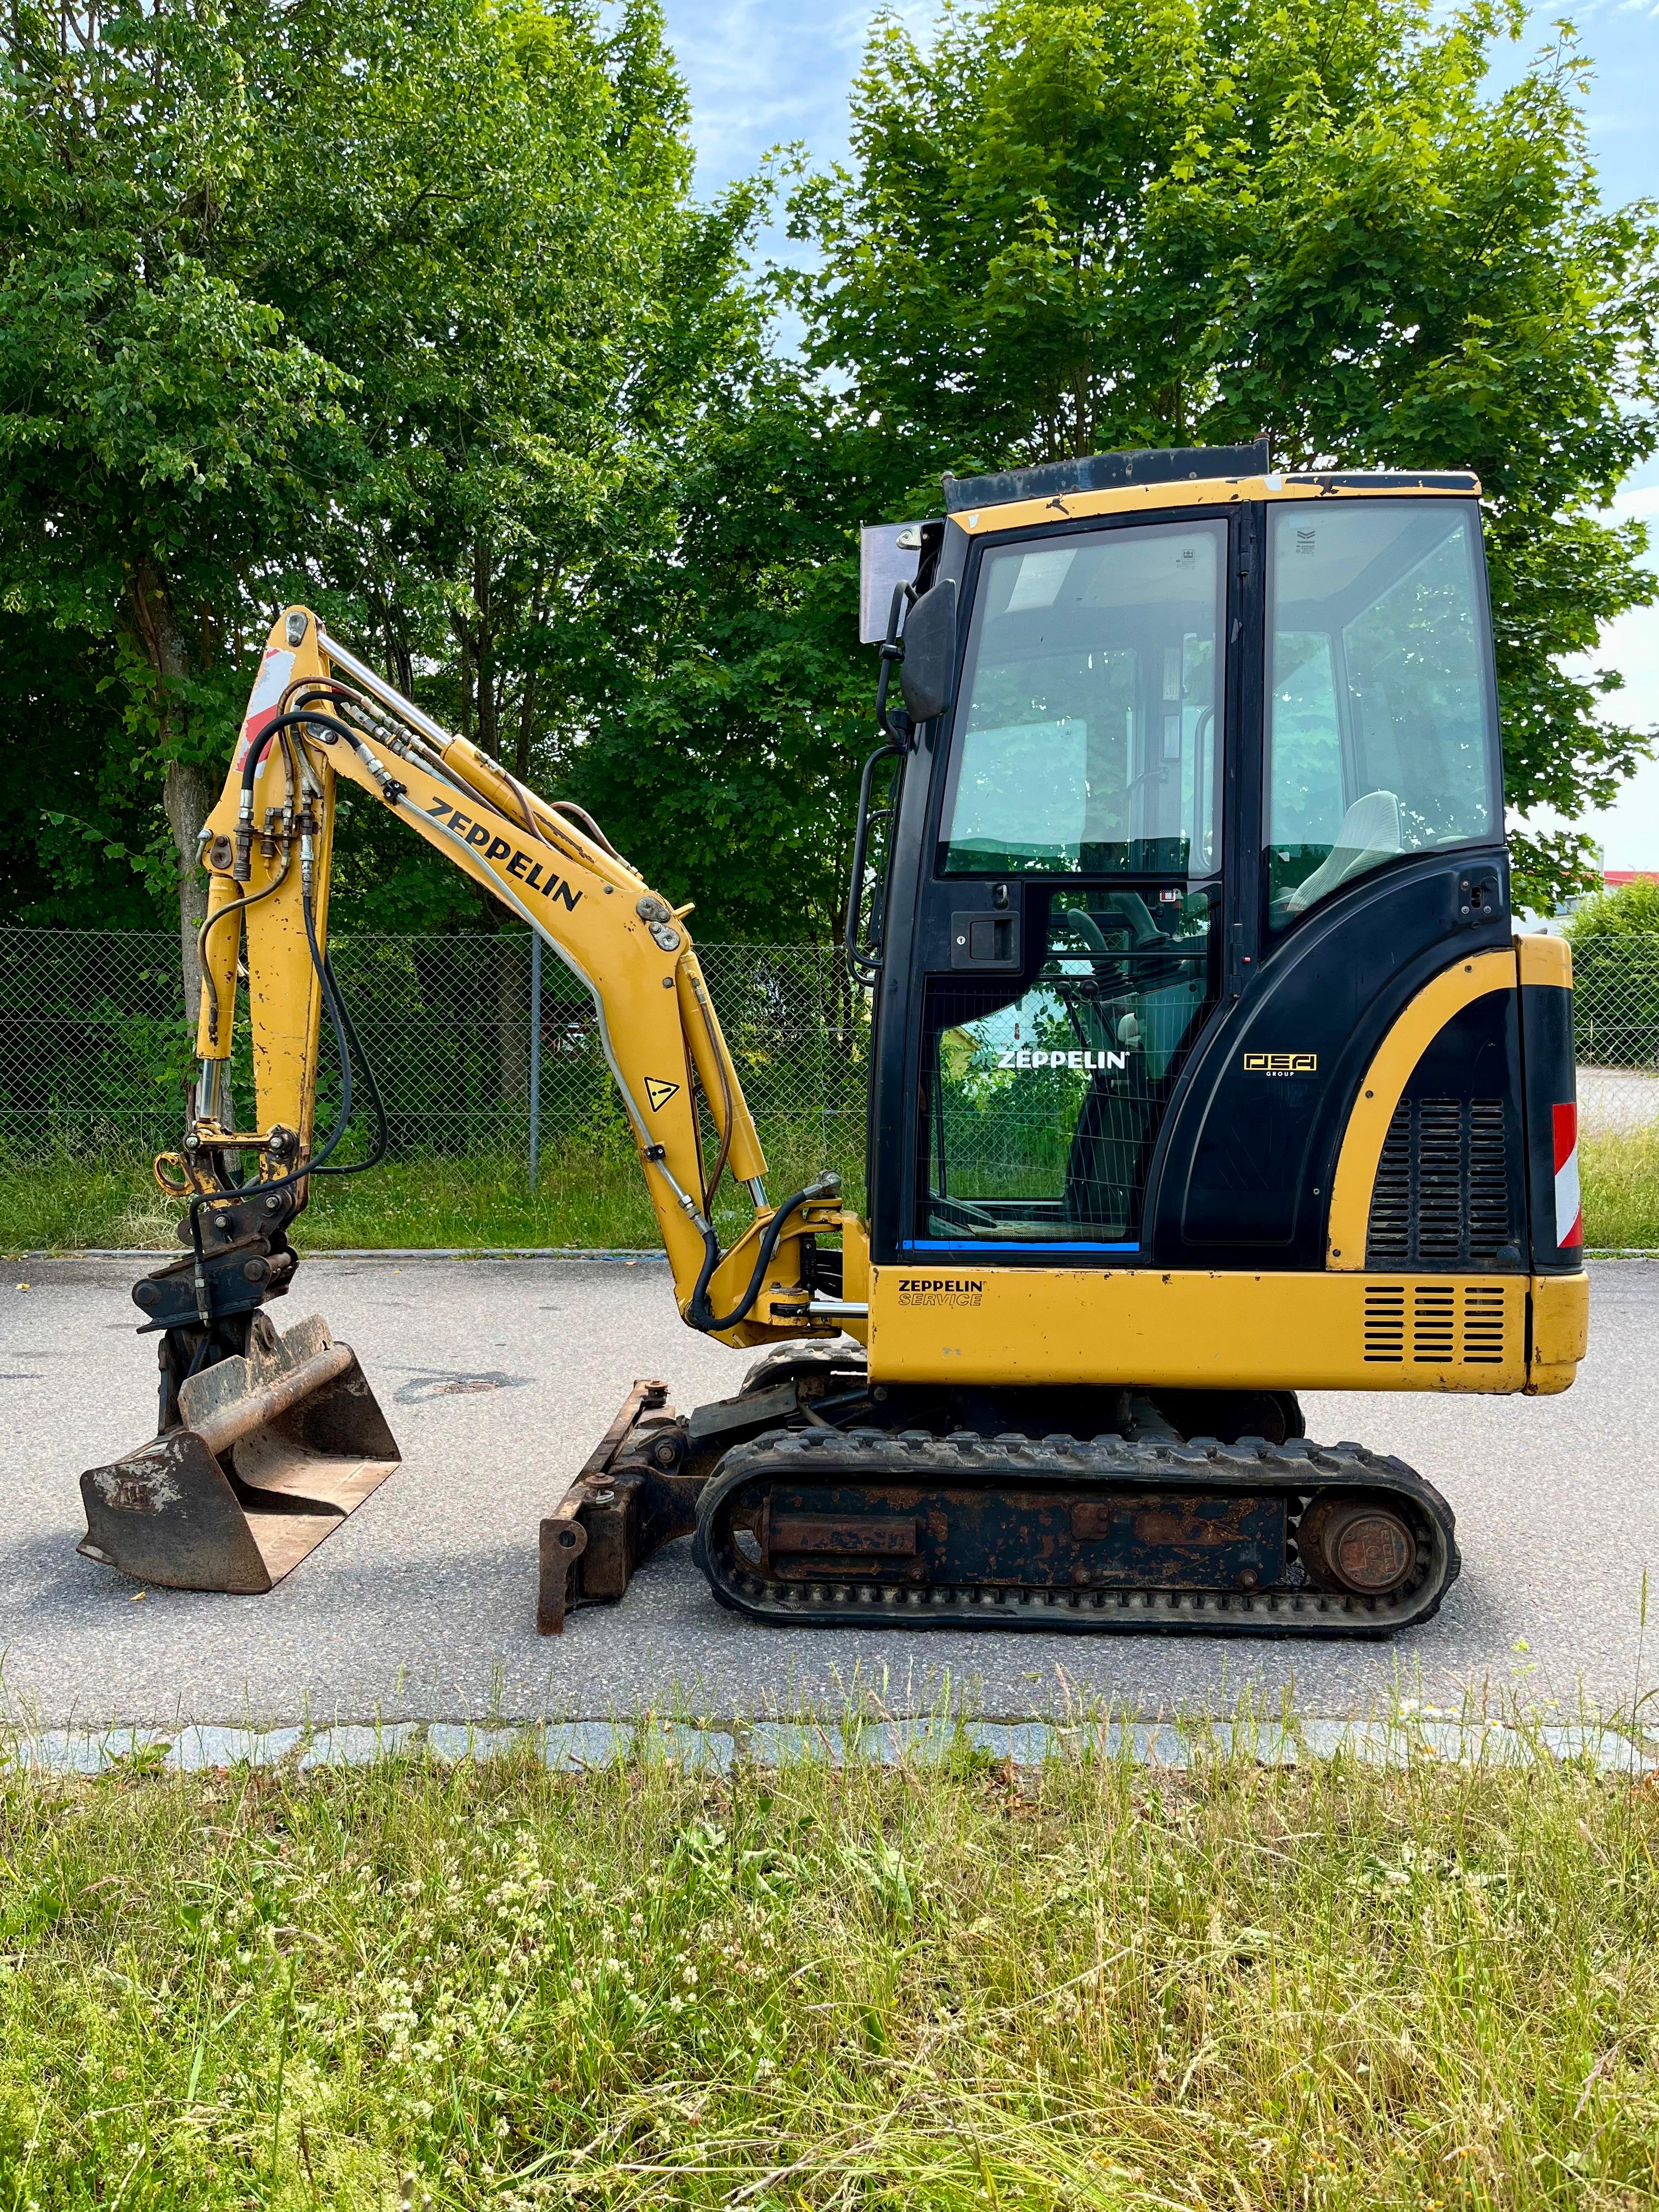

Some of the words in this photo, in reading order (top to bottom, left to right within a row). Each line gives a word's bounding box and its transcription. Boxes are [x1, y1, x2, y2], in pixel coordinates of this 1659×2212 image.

[425, 796, 583, 912] ZEPPELIN
[997, 1051, 1125, 1069] ZEPPELIN
[899, 1280, 982, 1291] ZEPPELIN
[898, 1293, 982, 1306] SERVICE
